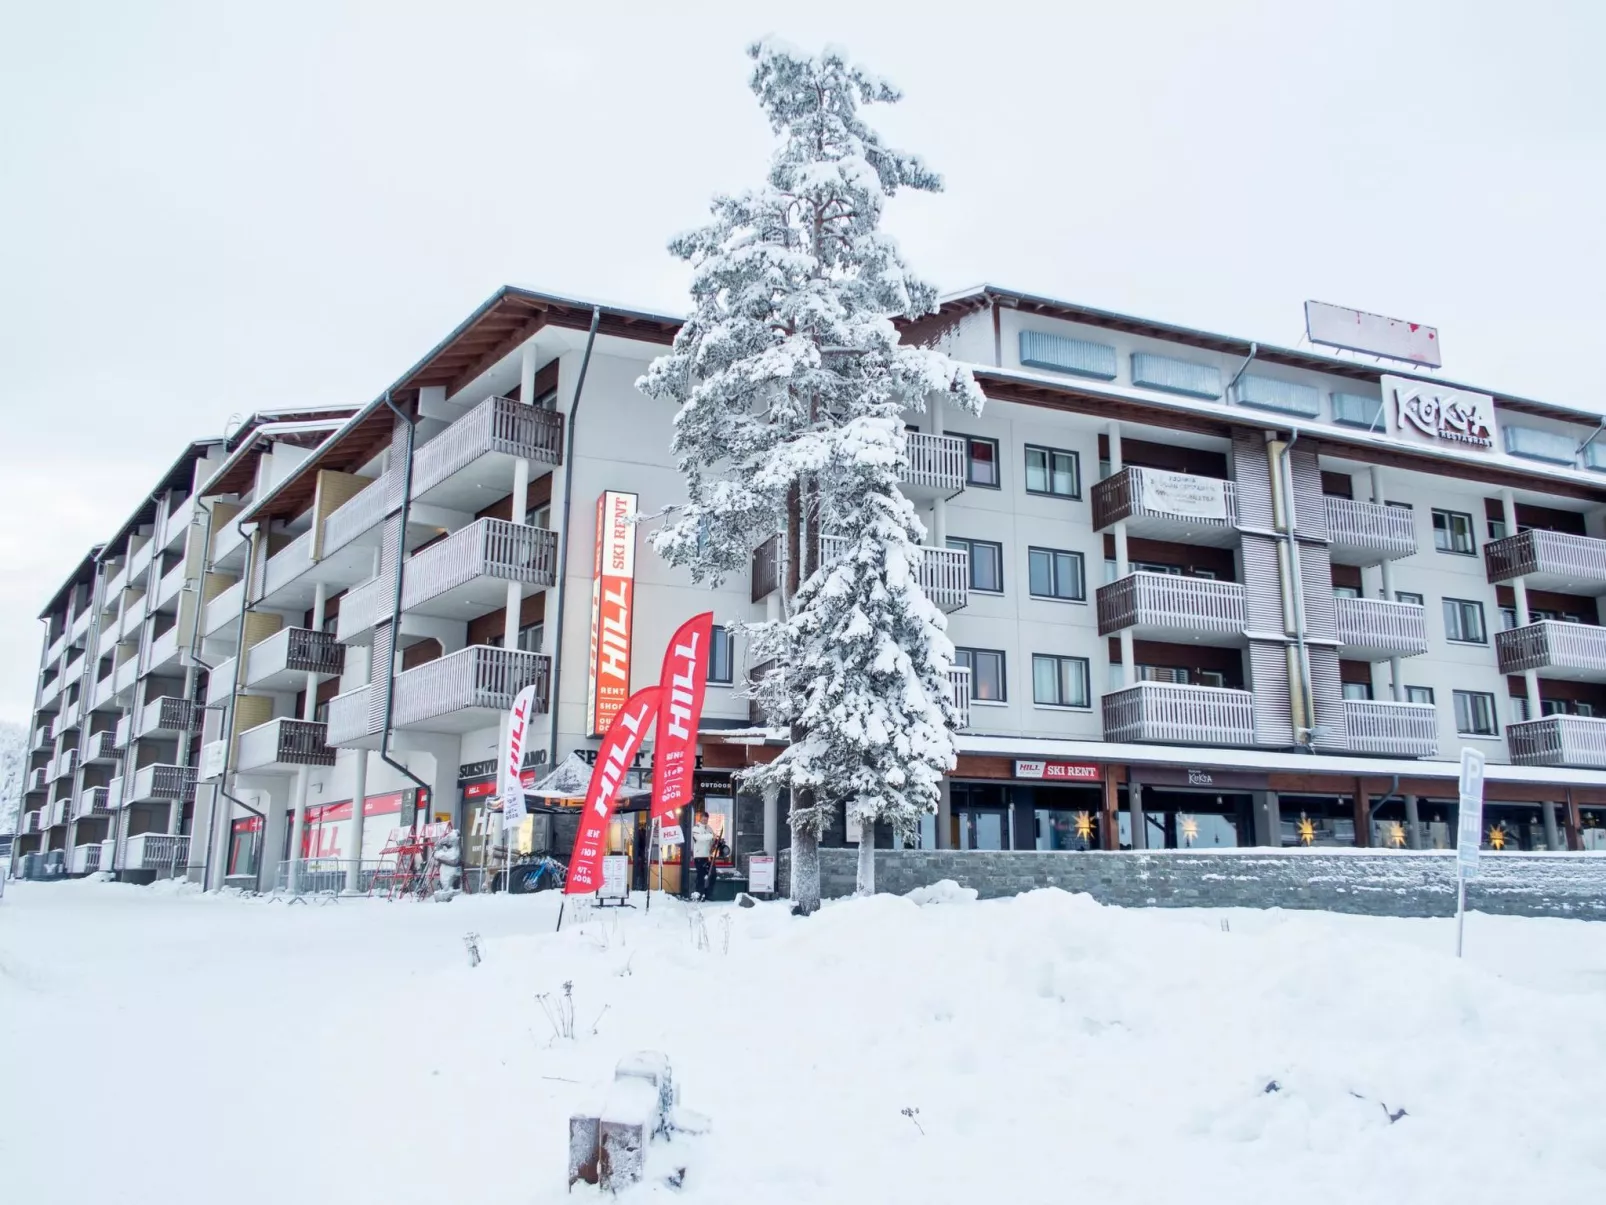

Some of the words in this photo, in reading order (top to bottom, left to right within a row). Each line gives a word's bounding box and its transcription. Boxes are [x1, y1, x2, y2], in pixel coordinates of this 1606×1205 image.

[614, 497, 627, 540] RENT
[613, 543, 625, 570] SKI
[601, 580, 628, 680] HILL
[600, 686, 625, 695] RENT
[668, 631, 700, 740] HILL
[595, 703, 649, 817] HILL
[1047, 765, 1065, 776] SKI
[1067, 766, 1097, 777] RENT
